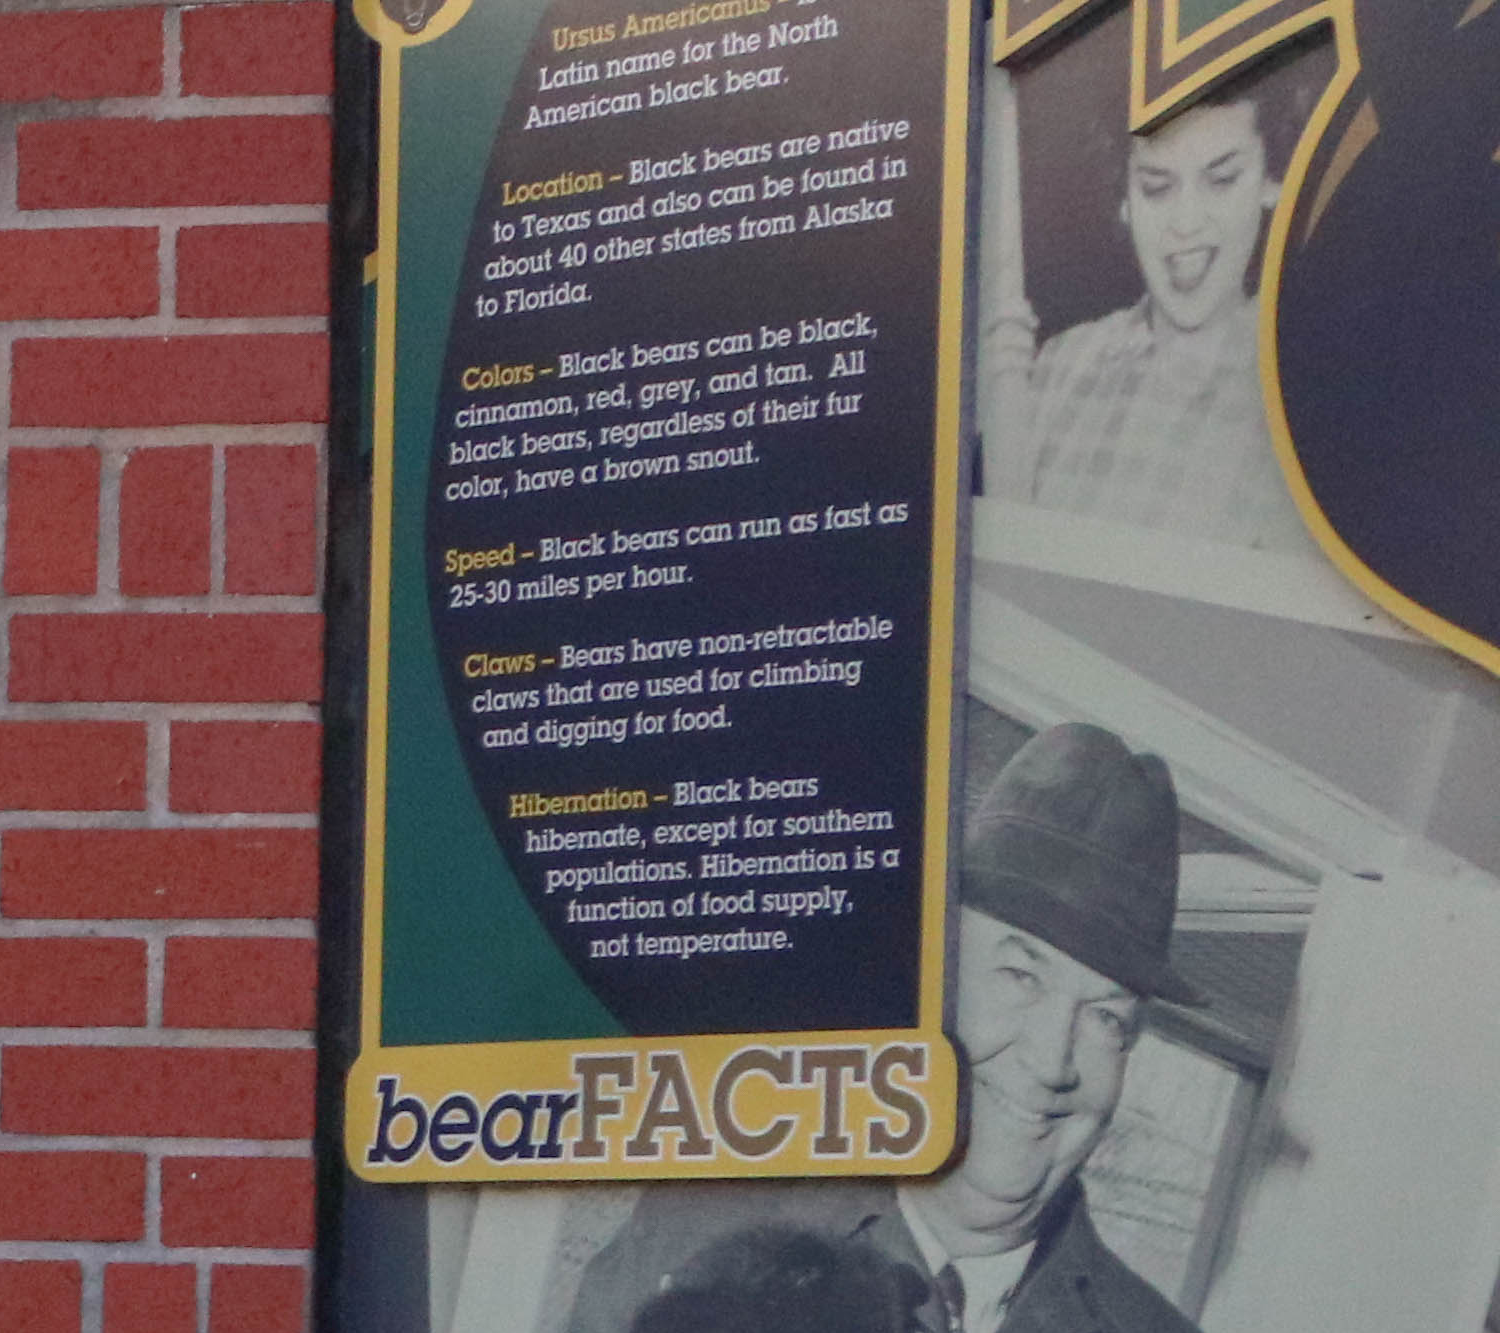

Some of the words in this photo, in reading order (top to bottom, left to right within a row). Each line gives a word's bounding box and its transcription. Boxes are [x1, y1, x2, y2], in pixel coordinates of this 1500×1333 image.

[539, 59, 600, 92] Latin
[605, 48, 677, 79] name
[682, 39, 716, 66] for
[721, 30, 762, 58] the
[767, 13, 839, 50] North
[523, 91, 643, 131] American
[648, 72, 719, 109] black
[724, 64, 789, 95] bear.
[493, 219, 516, 245] to
[521, 209, 592, 239] Texas
[597, 195, 646, 227] and
[651, 190, 702, 218] also
[707, 182, 756, 209] can
[761, 174, 795, 201] be
[800, 156, 876, 195] found
[881, 154, 908, 182] in
[475, 295, 499, 319] to
[503, 280, 592, 315] Florida.
[445, 473, 508, 502] color,
[514, 467, 575, 494] have
[580, 463, 598, 485] a
[603, 453, 681, 483] brown
[685, 439, 760, 472] snout.
[482, 721, 530, 749] and
[534, 715, 629, 749] digging
[633, 710, 667, 736] for
[671, 703, 732, 734] food.
[525, 823, 646, 854] hibernate,
[653, 815, 738, 848] except
[742, 813, 778, 839] for
[782, 807, 894, 837] southern
[545, 858, 693, 895] populations.
[700, 847, 848, 880] Hibernation
[853, 844, 875, 871] is
[880, 847, 901, 869] a
[590, 932, 630, 959] not
[634, 926, 794, 961] temperature.
[366, 1043, 930, 1168] bearFACTS
